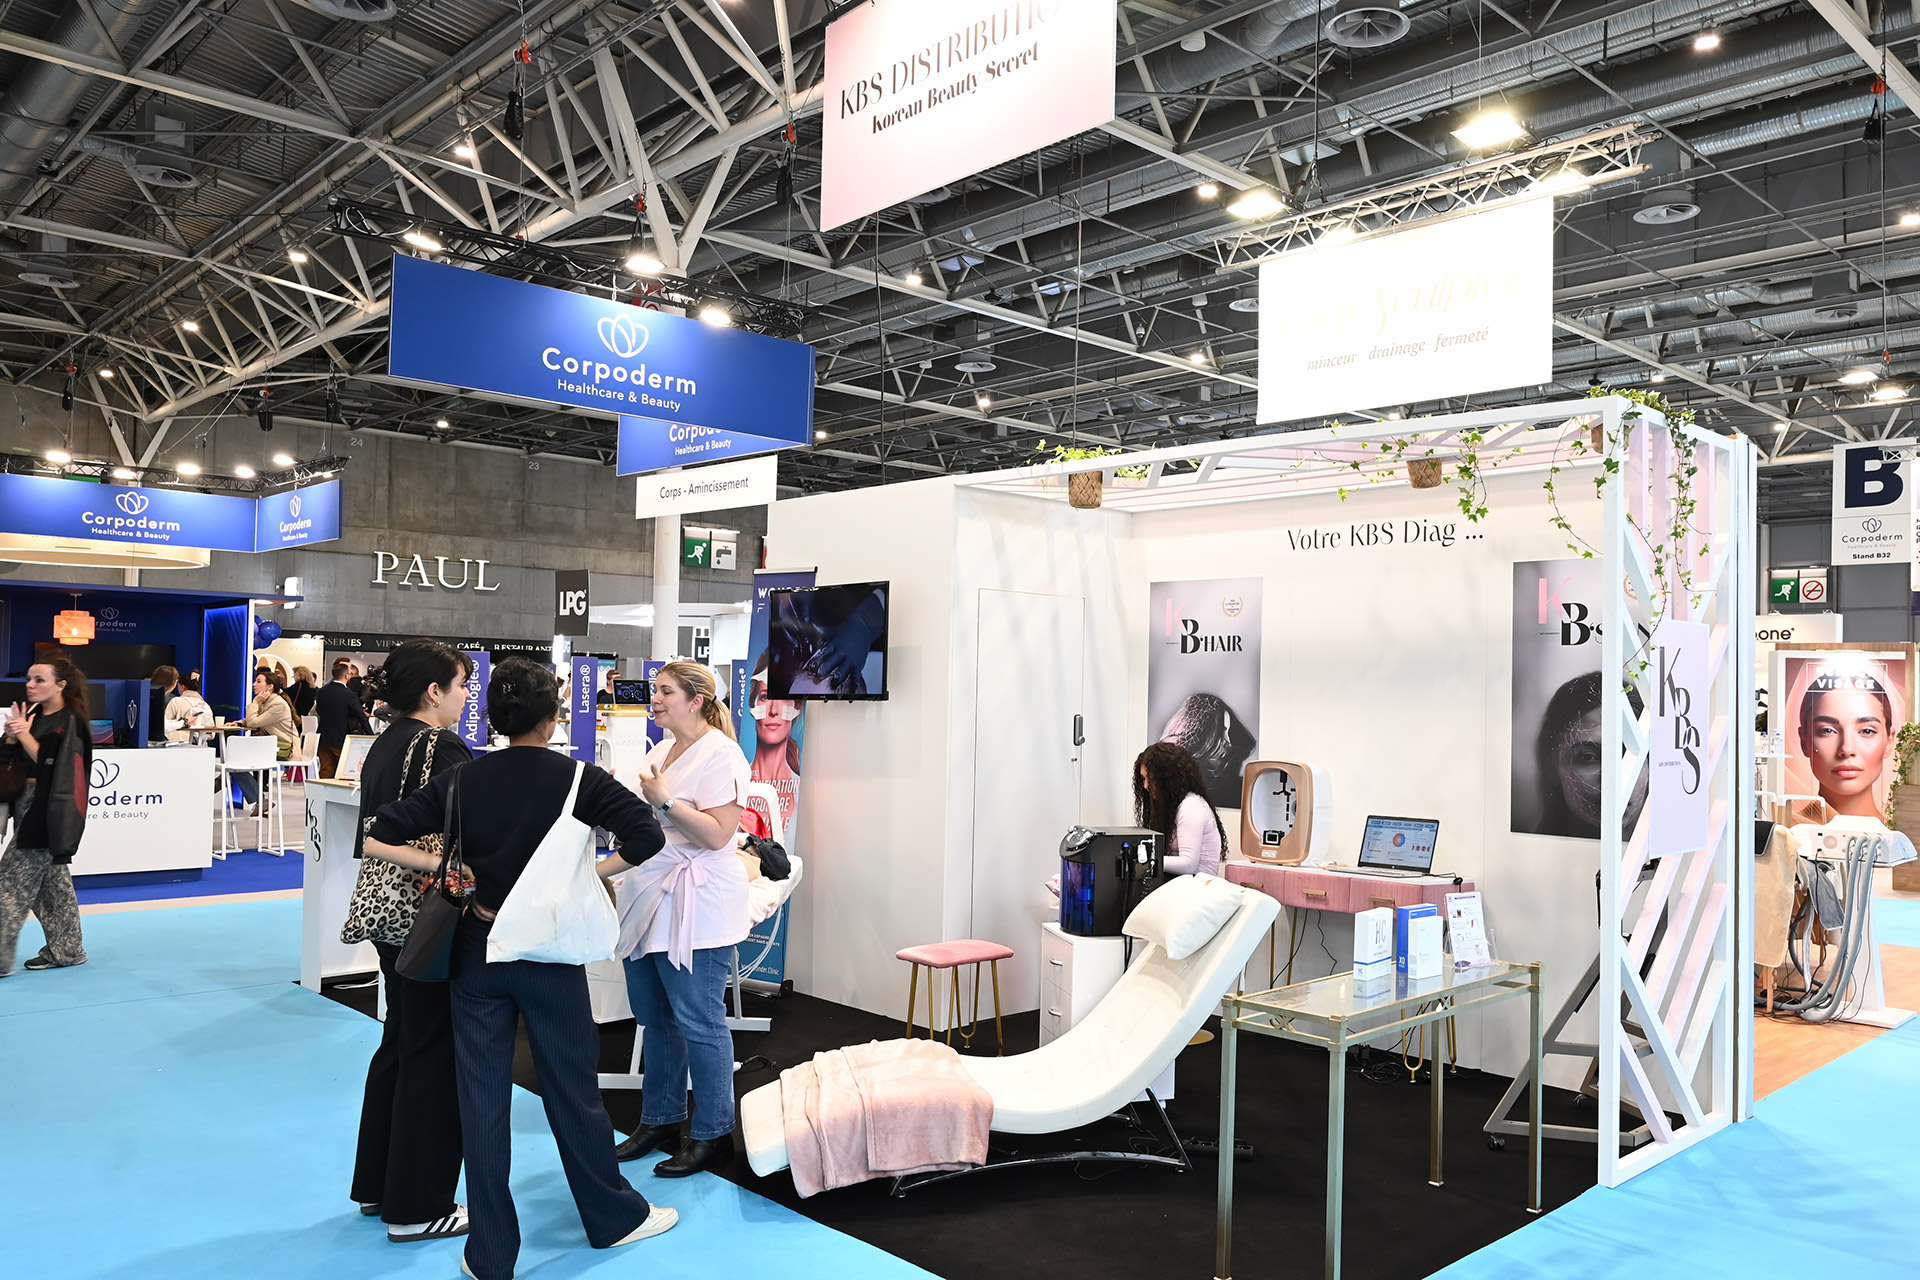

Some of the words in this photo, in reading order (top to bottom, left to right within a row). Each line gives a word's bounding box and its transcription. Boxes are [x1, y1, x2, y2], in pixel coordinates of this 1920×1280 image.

[841, 72, 882, 119] KBS
[872, 99, 923, 134] Korean
[928, 72, 981, 109] Beauty
[986, 40, 1039, 82] Secret
[1307, 351, 1358, 371] minceur
[1368, 340, 1426, 361] drainage
[1434, 326, 1490, 352] fermeté
[542, 347, 697, 396] Corpoderm
[557, 379, 625, 401] Healthcare
[628, 392, 638, 403] &
[641, 394, 681, 413] Beauty
[351, 438, 363, 447] 24
[675, 443, 705, 456] Healthcare
[705, 441, 711, 451] &
[711, 439, 732, 449] Beauty
[528, 461, 540, 470] 23
[1844, 446, 1904, 509] B
[660, 486, 682, 501] Corps
[688, 476, 749, 496] Amincissement
[81, 511, 181, 532] Corpoderm
[91, 527, 134, 538] Healthcare
[135, 530, 142, 538] &
[144, 531, 170, 541] Beauty
[279, 518, 312, 534] Corpoderm
[1288, 528, 1341, 551] Votre
[1350, 522, 1394, 546] KBS
[1404, 519, 1457, 546] Diag
[1842, 533, 1903, 544] Corpoderm
[371, 551, 501, 591] PAUL
[1658, 645, 1701, 795] KBS
[114, 810, 149, 820] Beauty
[305, 798, 322, 862] KBS
